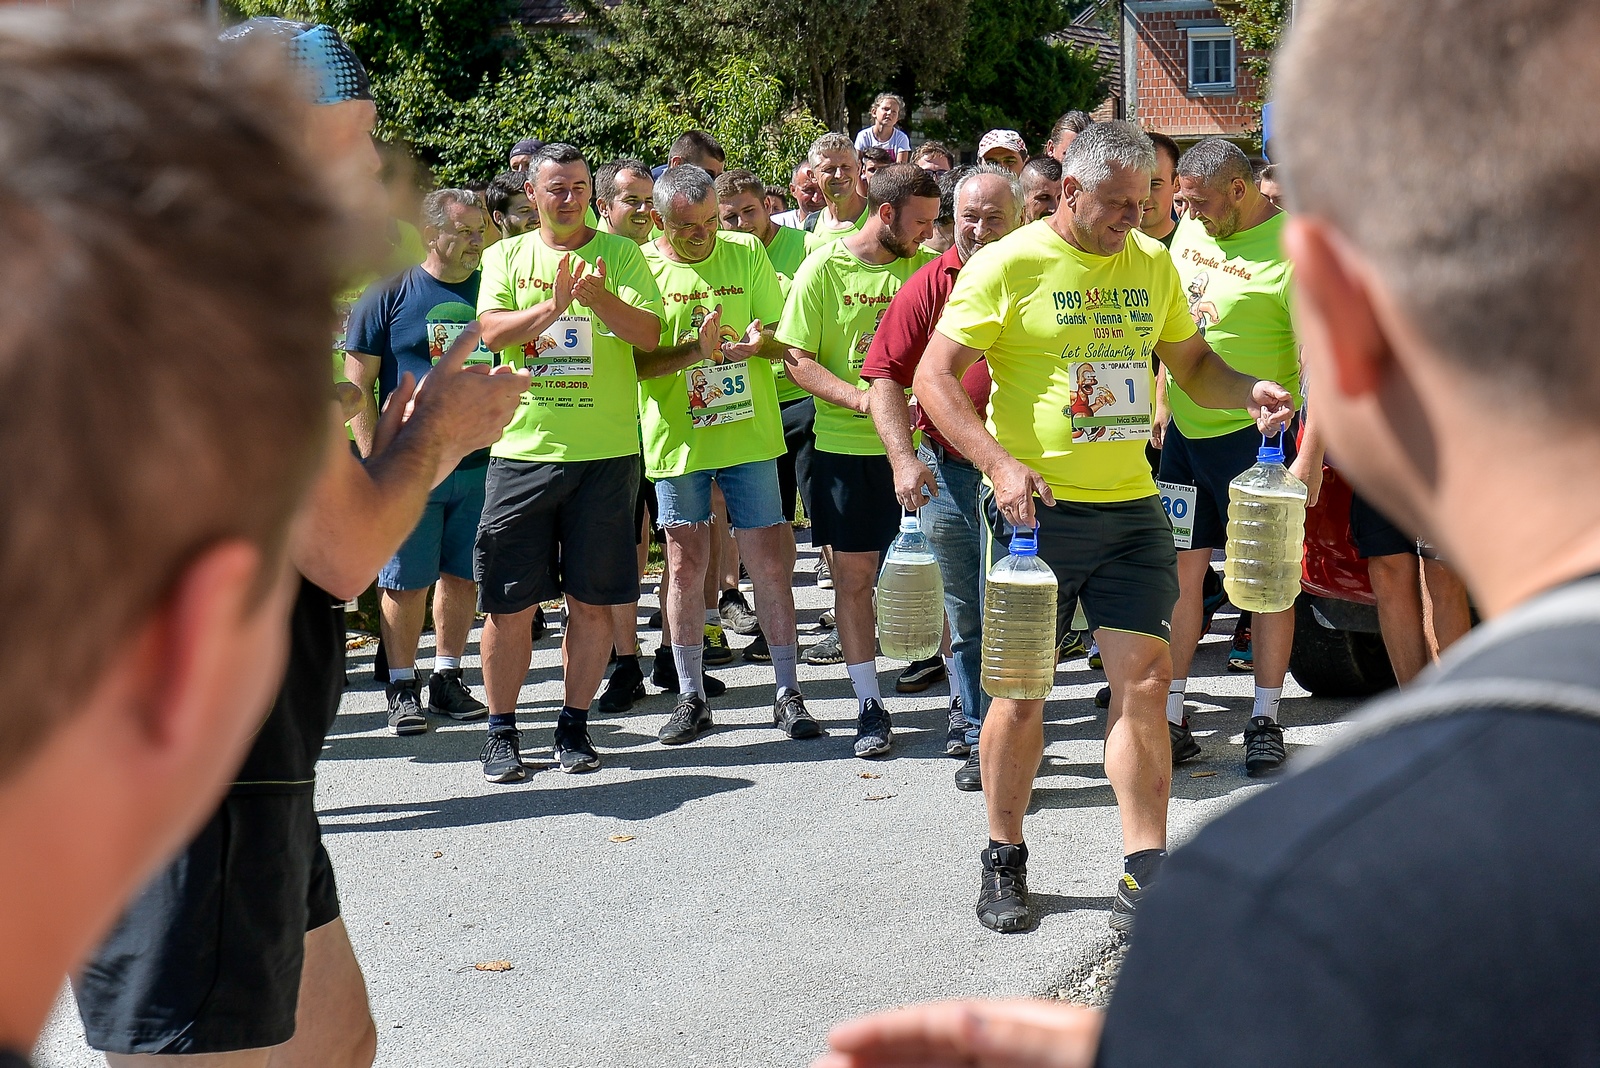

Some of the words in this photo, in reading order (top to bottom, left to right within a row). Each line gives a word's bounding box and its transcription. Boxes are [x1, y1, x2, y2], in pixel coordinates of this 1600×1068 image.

[1181, 248, 1190, 260] 3.
[1223, 264, 1253, 281] utrka
[713, 284, 745, 297] utrka
[843, 294, 855, 307] 3.
[1052, 290, 1082, 310] 1989
[1122, 288, 1150, 308] 2019
[1056, 312, 1087, 326] Gdańsk
[1093, 312, 1123, 325] Vienna
[1129, 310, 1154, 323] Milano
[564, 328, 578, 349] 5
[1093, 327, 1110, 339] 1039
[1111, 327, 1124, 339] km
[1061, 343, 1081, 359] Let
[1085, 342, 1136, 362] Solidarity
[722, 374, 746, 396] 35
[1125, 378, 1136, 404] 1
[1161, 495, 1188, 519] 30
